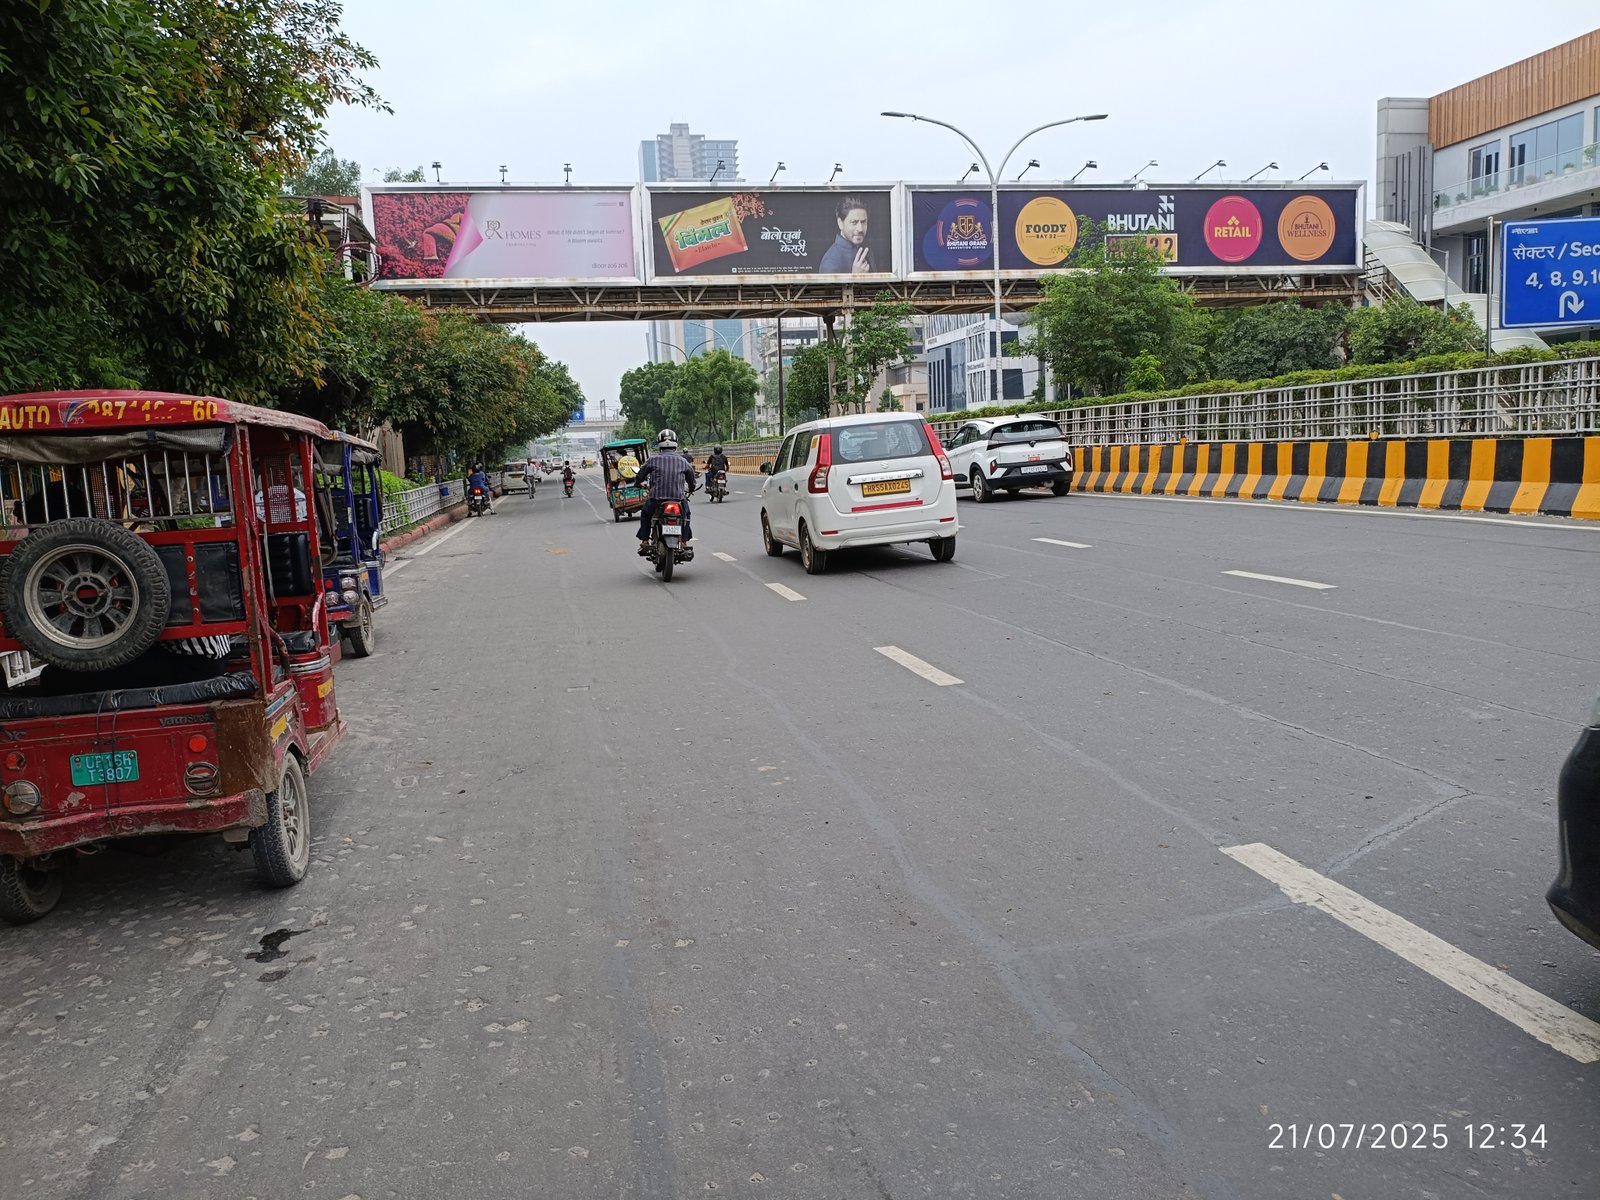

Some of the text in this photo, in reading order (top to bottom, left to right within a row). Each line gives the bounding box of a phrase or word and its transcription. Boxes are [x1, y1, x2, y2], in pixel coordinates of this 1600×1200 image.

[1107, 213, 1175, 231] BHUTANI
[505, 230, 542, 240] HOMES
[1025, 224, 1067, 234] FOODY
[1214, 226, 1252, 238] RETAIL
[1287, 230, 1327, 238] WELLNESS
[1512, 242, 1556, 260] सैक्टर
[1525, 272, 1544, 290] 4,
[1550, 270, 1568, 288] 8,
[1590, 269, 1600, 284] 1
[0, 405, 50, 430] AUTO
[867, 480, 909, 493] HR55AX0245
